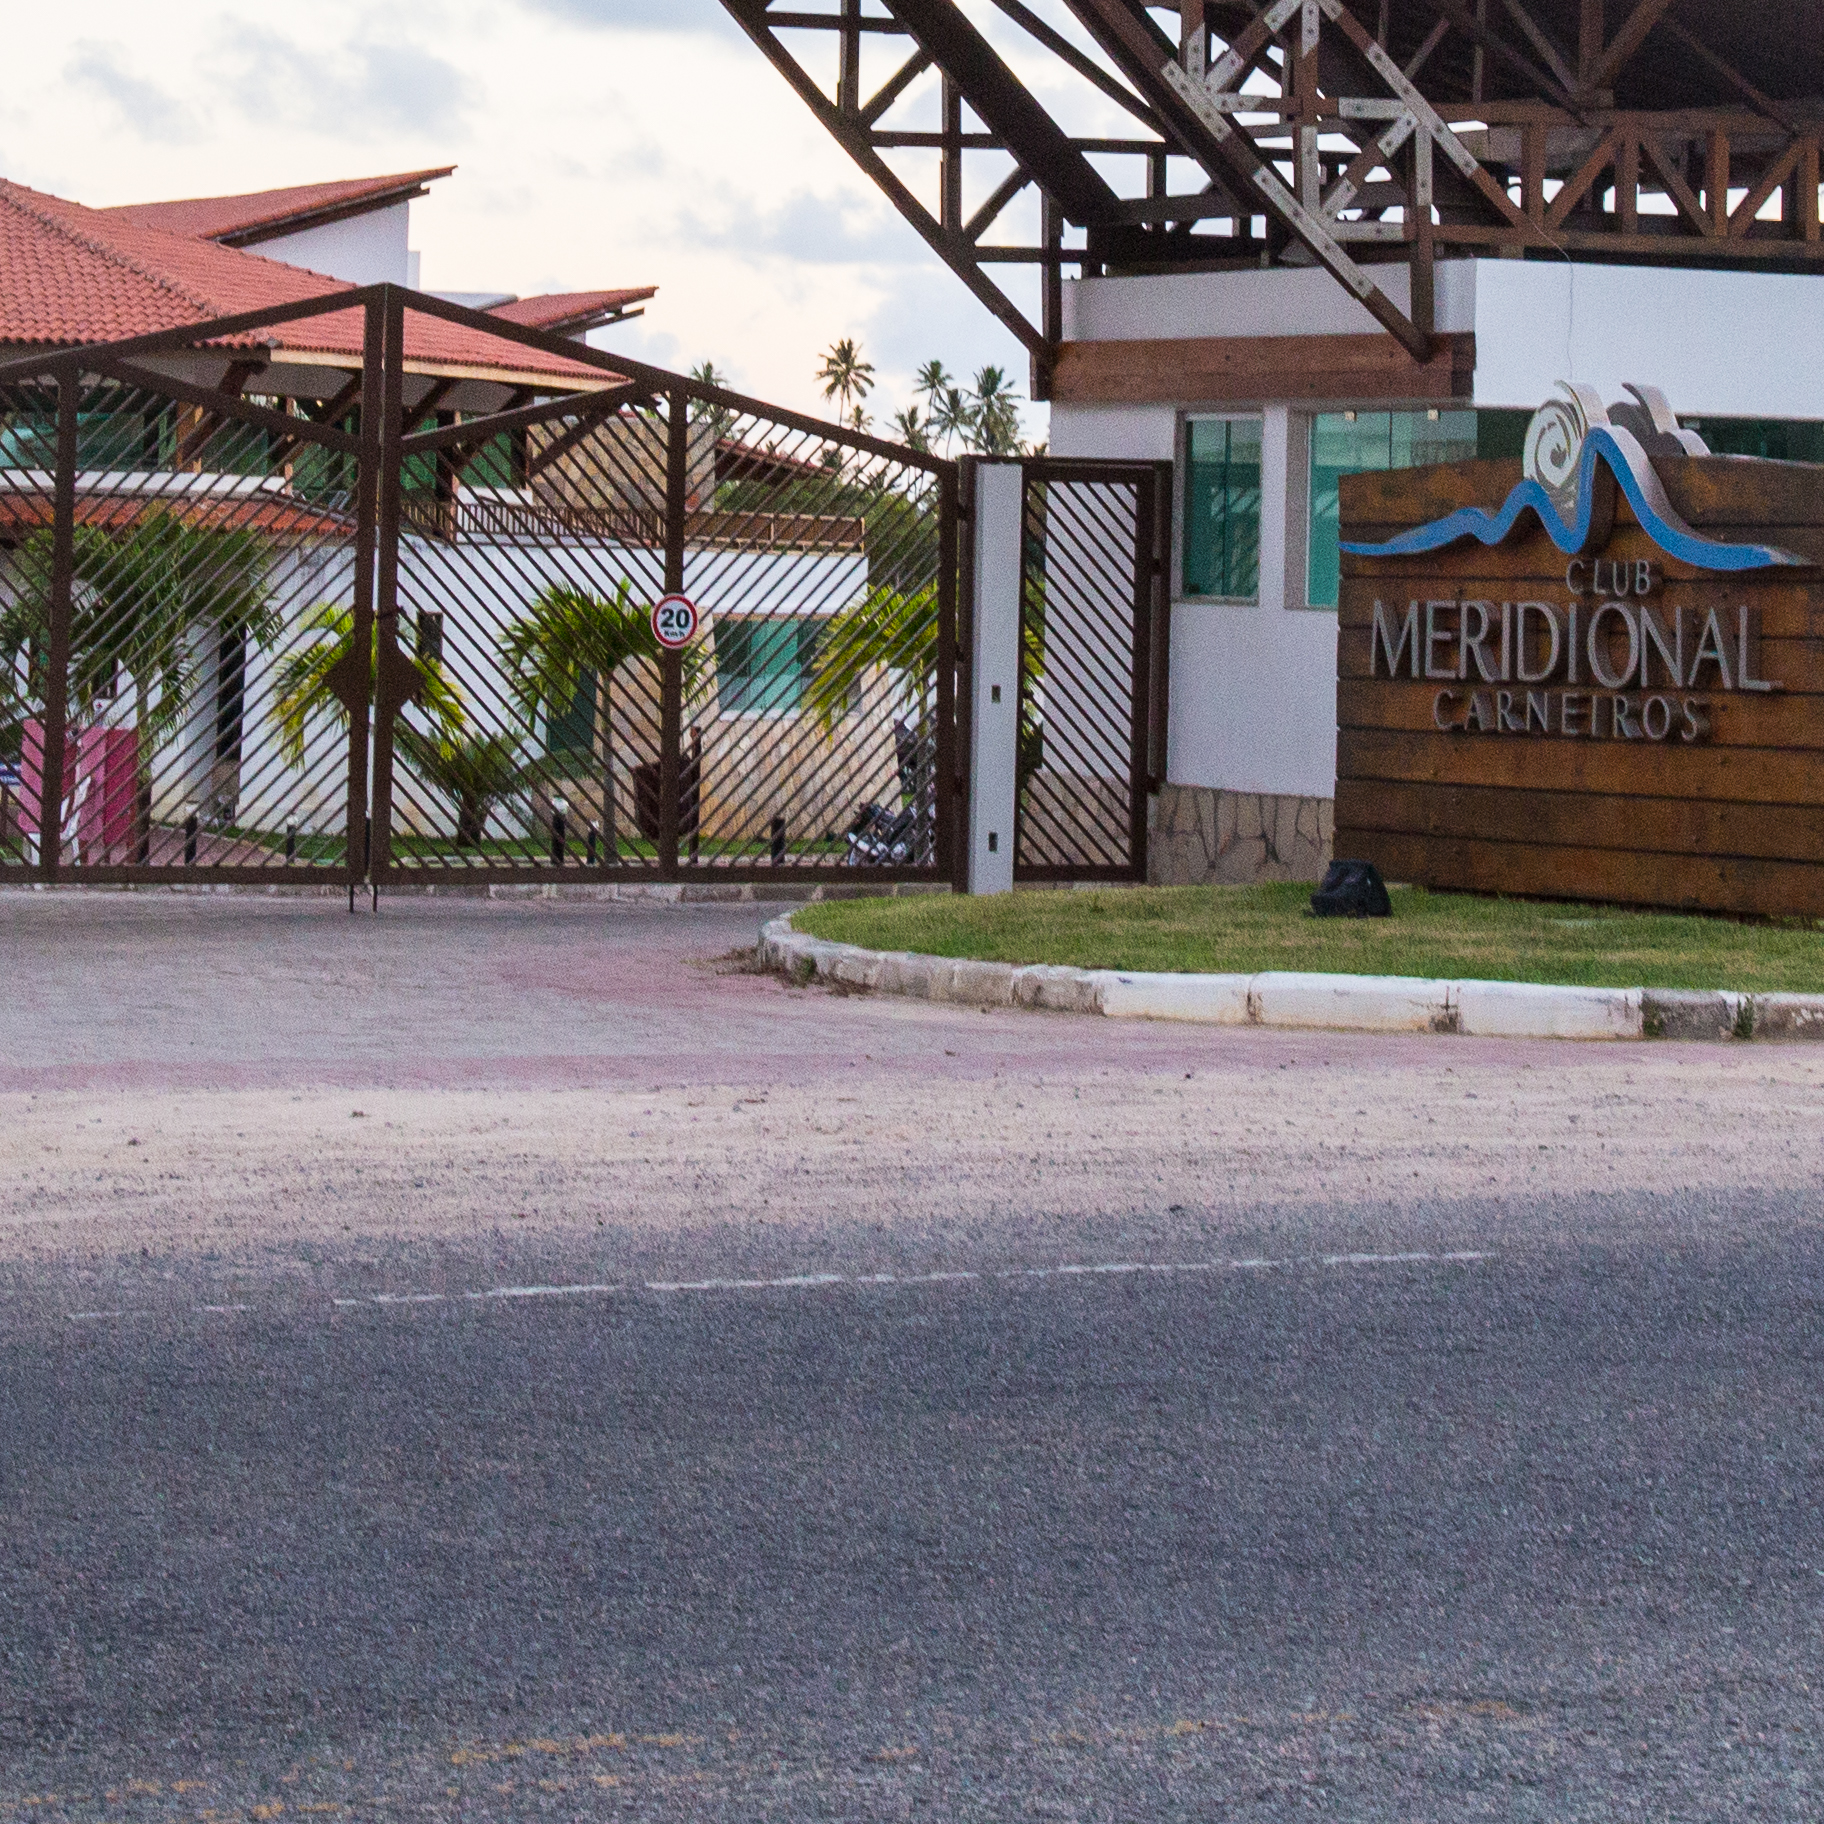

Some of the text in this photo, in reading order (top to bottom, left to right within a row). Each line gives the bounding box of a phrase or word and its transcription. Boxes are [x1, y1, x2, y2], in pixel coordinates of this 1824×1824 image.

[1566, 559, 1651, 596] CLUB
[661, 608, 690, 628] 20
[1370, 599, 1778, 691] MERIDIONAL
[1433, 689, 1703, 742] CARNEIROS
